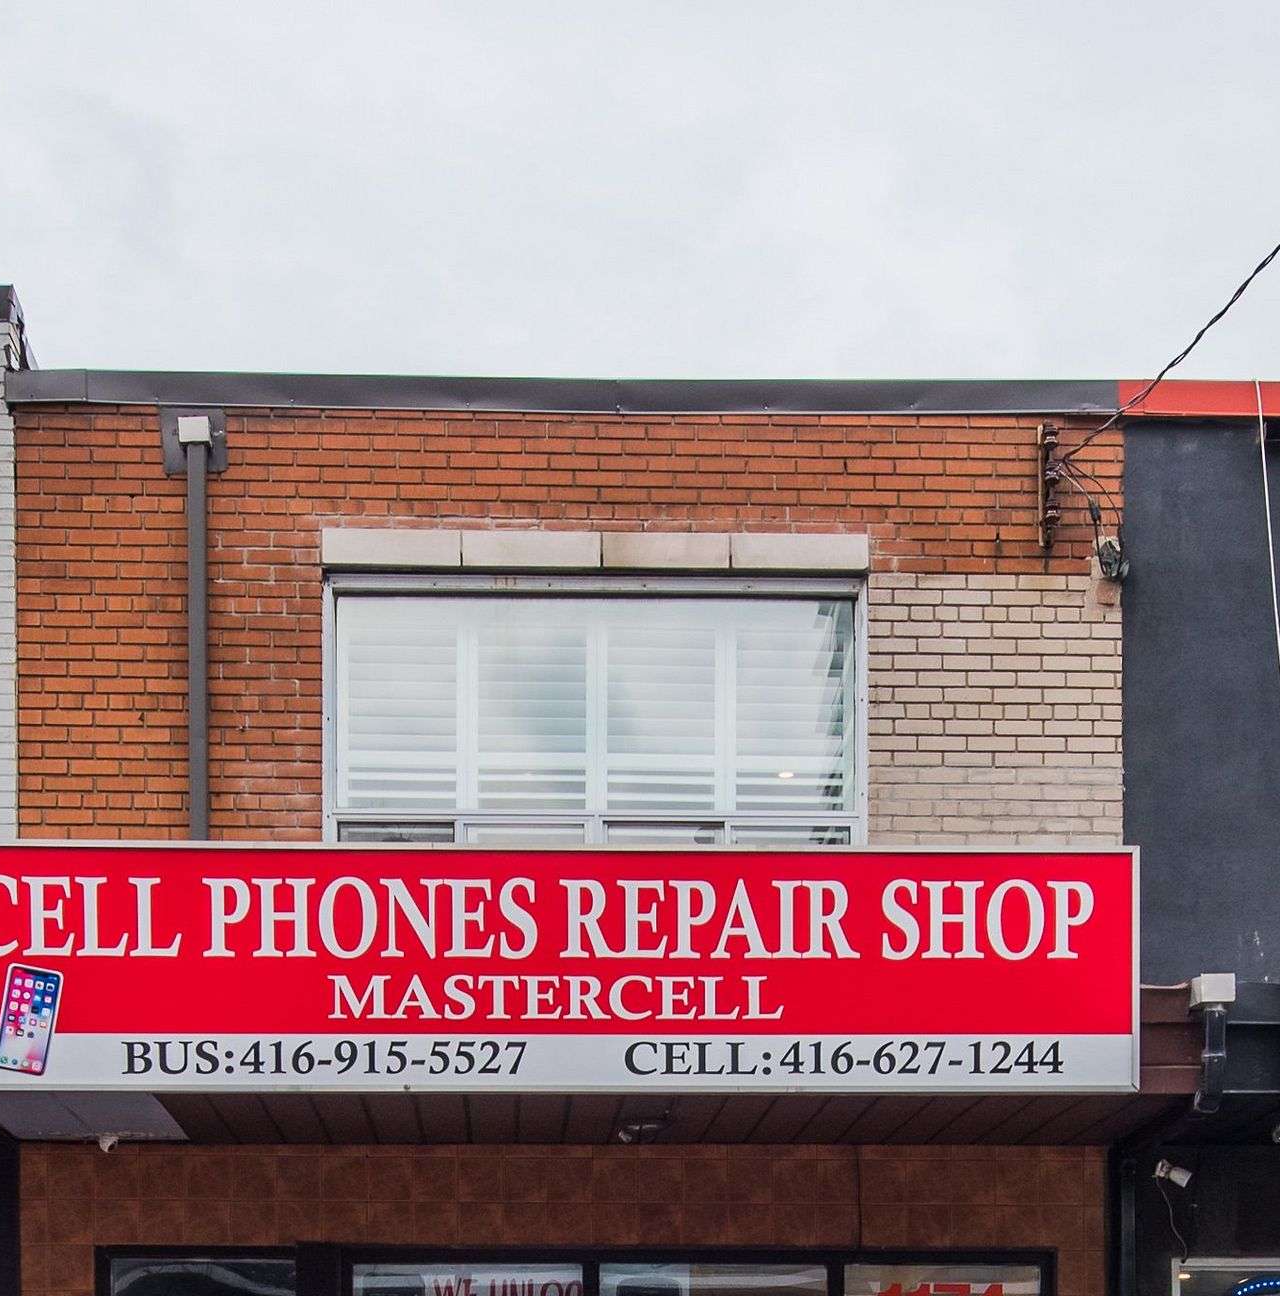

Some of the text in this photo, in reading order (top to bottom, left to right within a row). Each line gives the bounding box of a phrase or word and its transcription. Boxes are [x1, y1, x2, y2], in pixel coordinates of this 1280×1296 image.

[202, 876, 538, 960] PHONES
[559, 878, 860, 960] REPAIR
[881, 878, 1095, 961] SHOP
[327, 974, 785, 1021] MASTERCELL
[122, 1039, 1065, 1077] BUS:416-915-5527 CELL:416-627-1244
